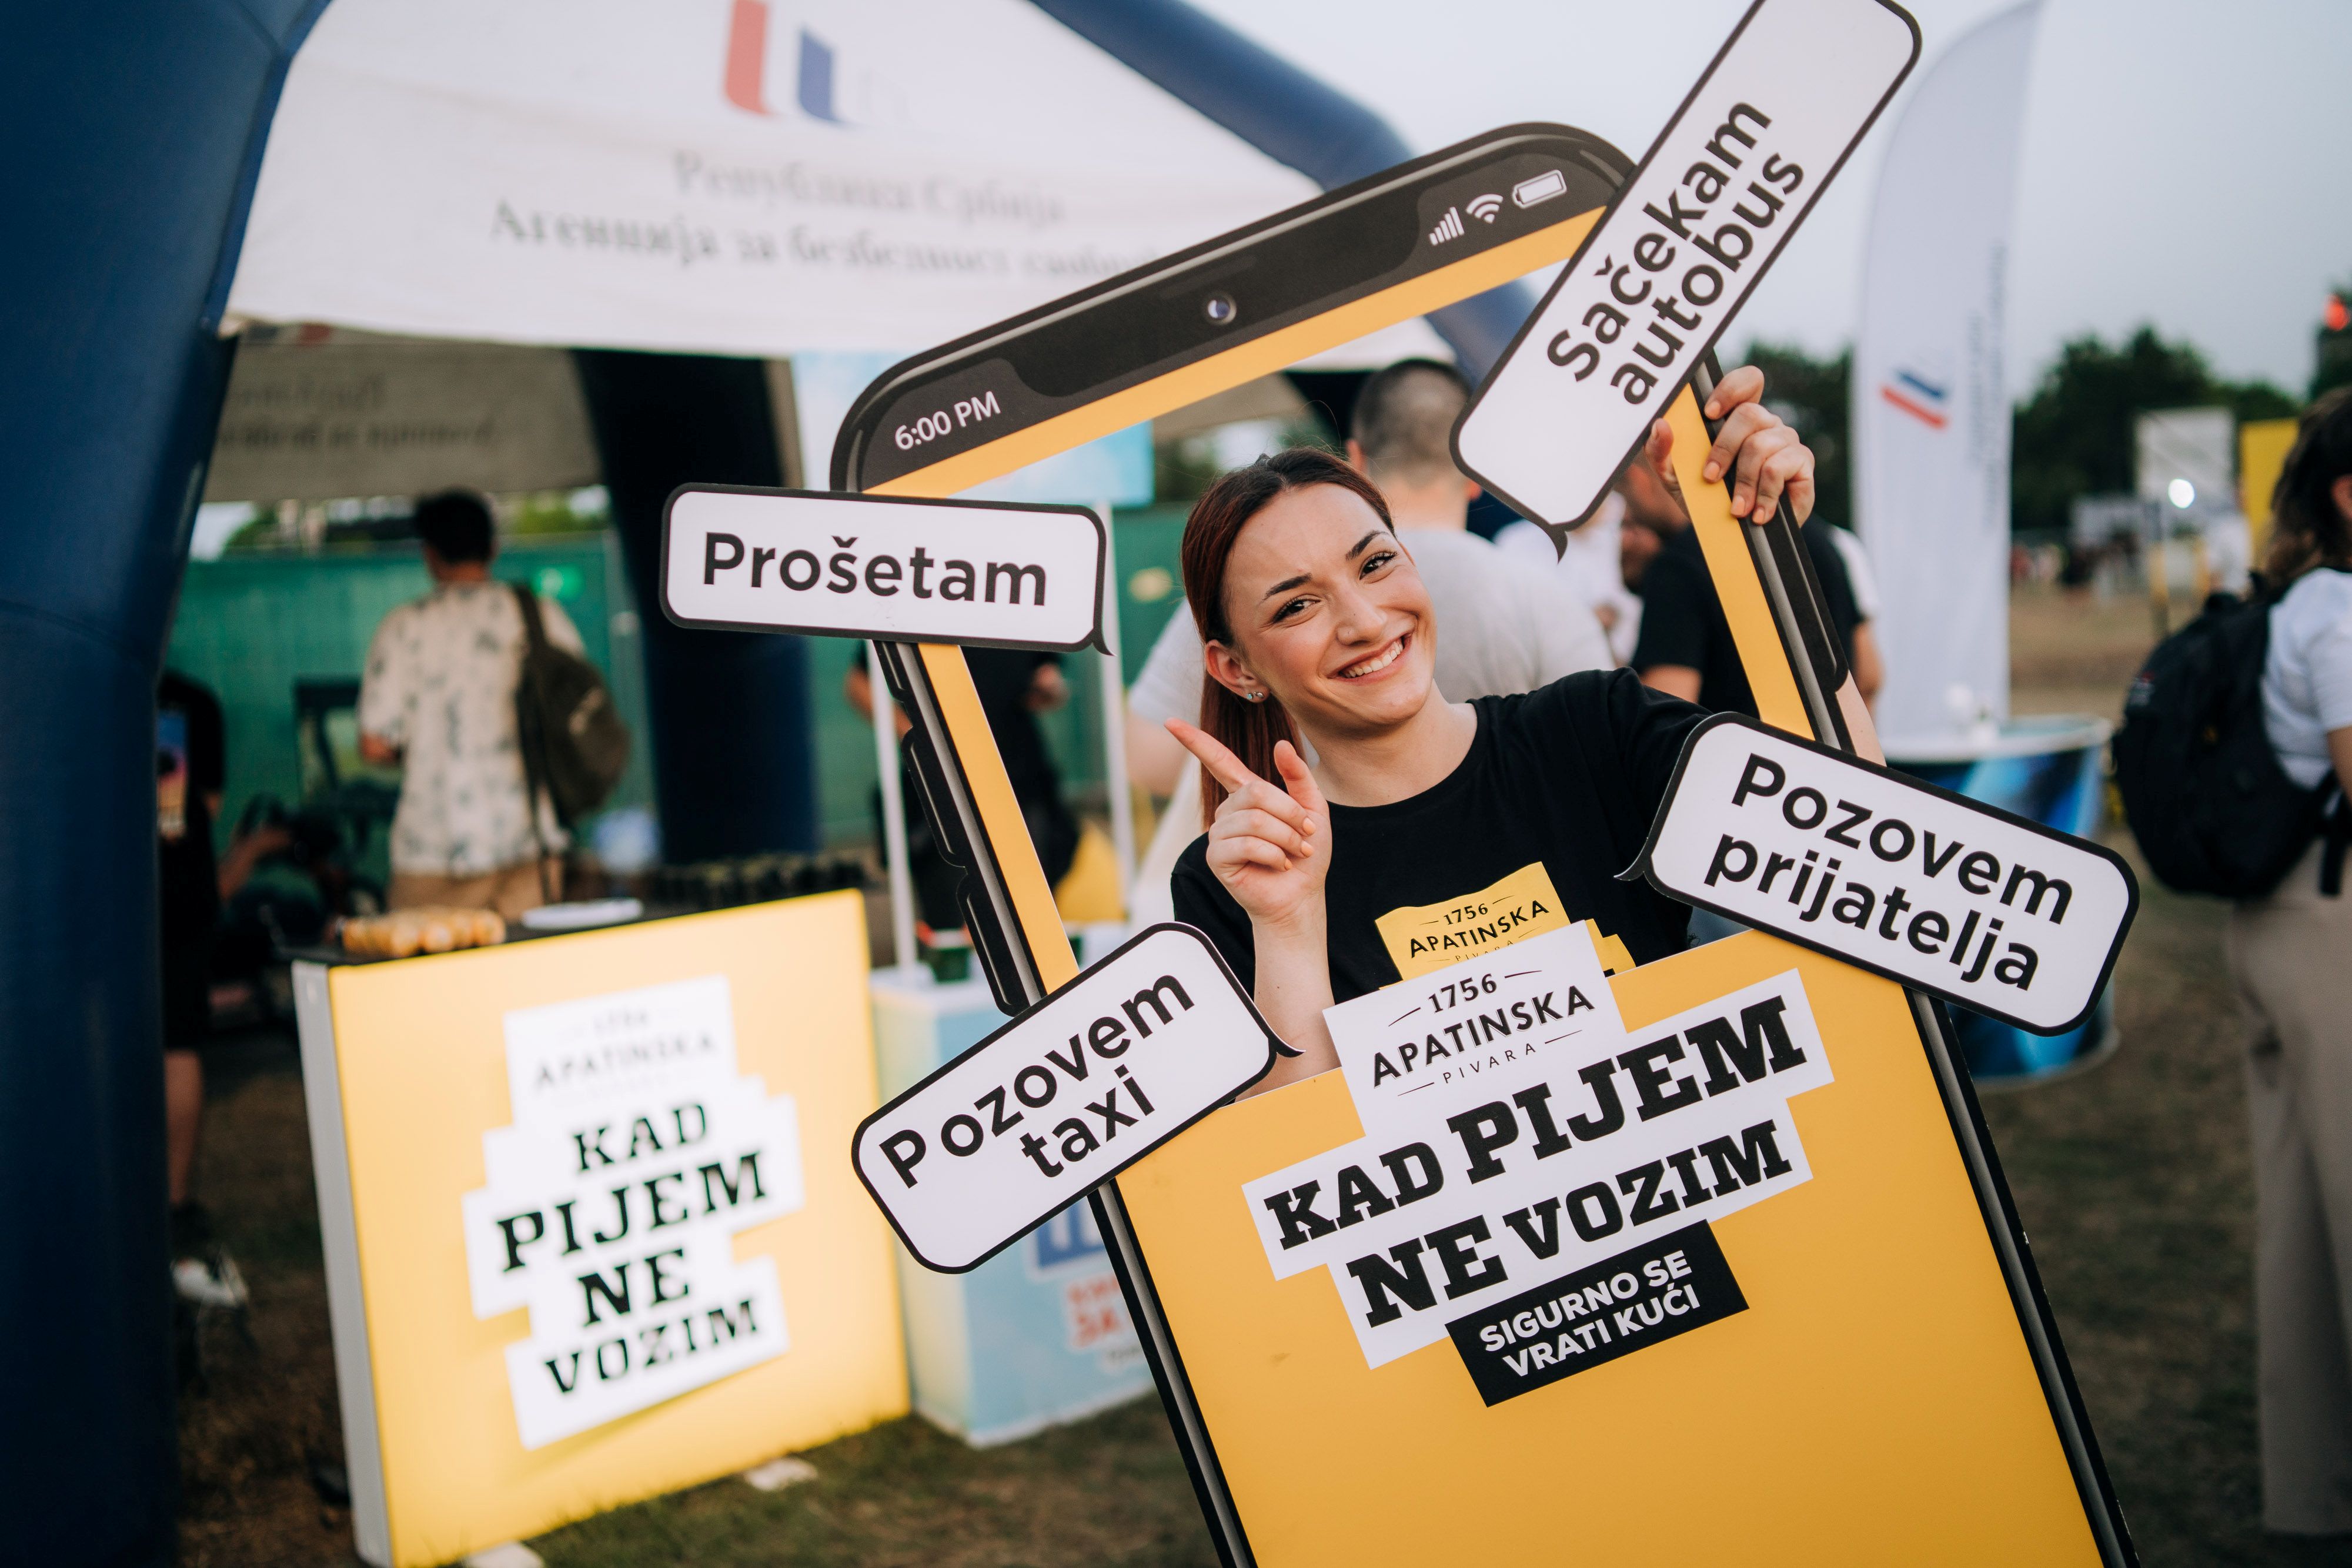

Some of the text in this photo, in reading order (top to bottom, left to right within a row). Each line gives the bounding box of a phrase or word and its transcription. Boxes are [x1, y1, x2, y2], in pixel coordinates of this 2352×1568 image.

[1548, 103, 1771, 382] Sačekam
[1611, 153, 1803, 404] autobus
[896, 392, 1000, 449] 6:00 PM
[704, 532, 1045, 606] Prošetam
[1732, 753, 2072, 924] Pozovem
[1411, 901, 1549, 958] APATINSKA
[1444, 904, 1488, 925] 1756
[1704, 834, 2038, 991] prijatelja
[1374, 986, 1595, 1087] APATINSKA
[1429, 974, 1496, 1012] 1756
[534, 1030, 716, 1090] APATINSKA
[879, 975, 1194, 1188] Pozovem
[1443, 1044, 1535, 1083] PIVARA
[573, 1102, 708, 1175] KAD
[1020, 1064, 1155, 1177] taxi
[1264, 995, 1807, 1250] KAD PIJEM
[495, 1150, 767, 1273] PIJEM
[1346, 1119, 1792, 1328] NE VOZIM
[576, 1246, 689, 1328] NE
[1480, 1251, 1692, 1351] SIGURNO SE
[1502, 1283, 1700, 1376] VRATI KUĆI
[543, 1298, 757, 1395] VOZIM
